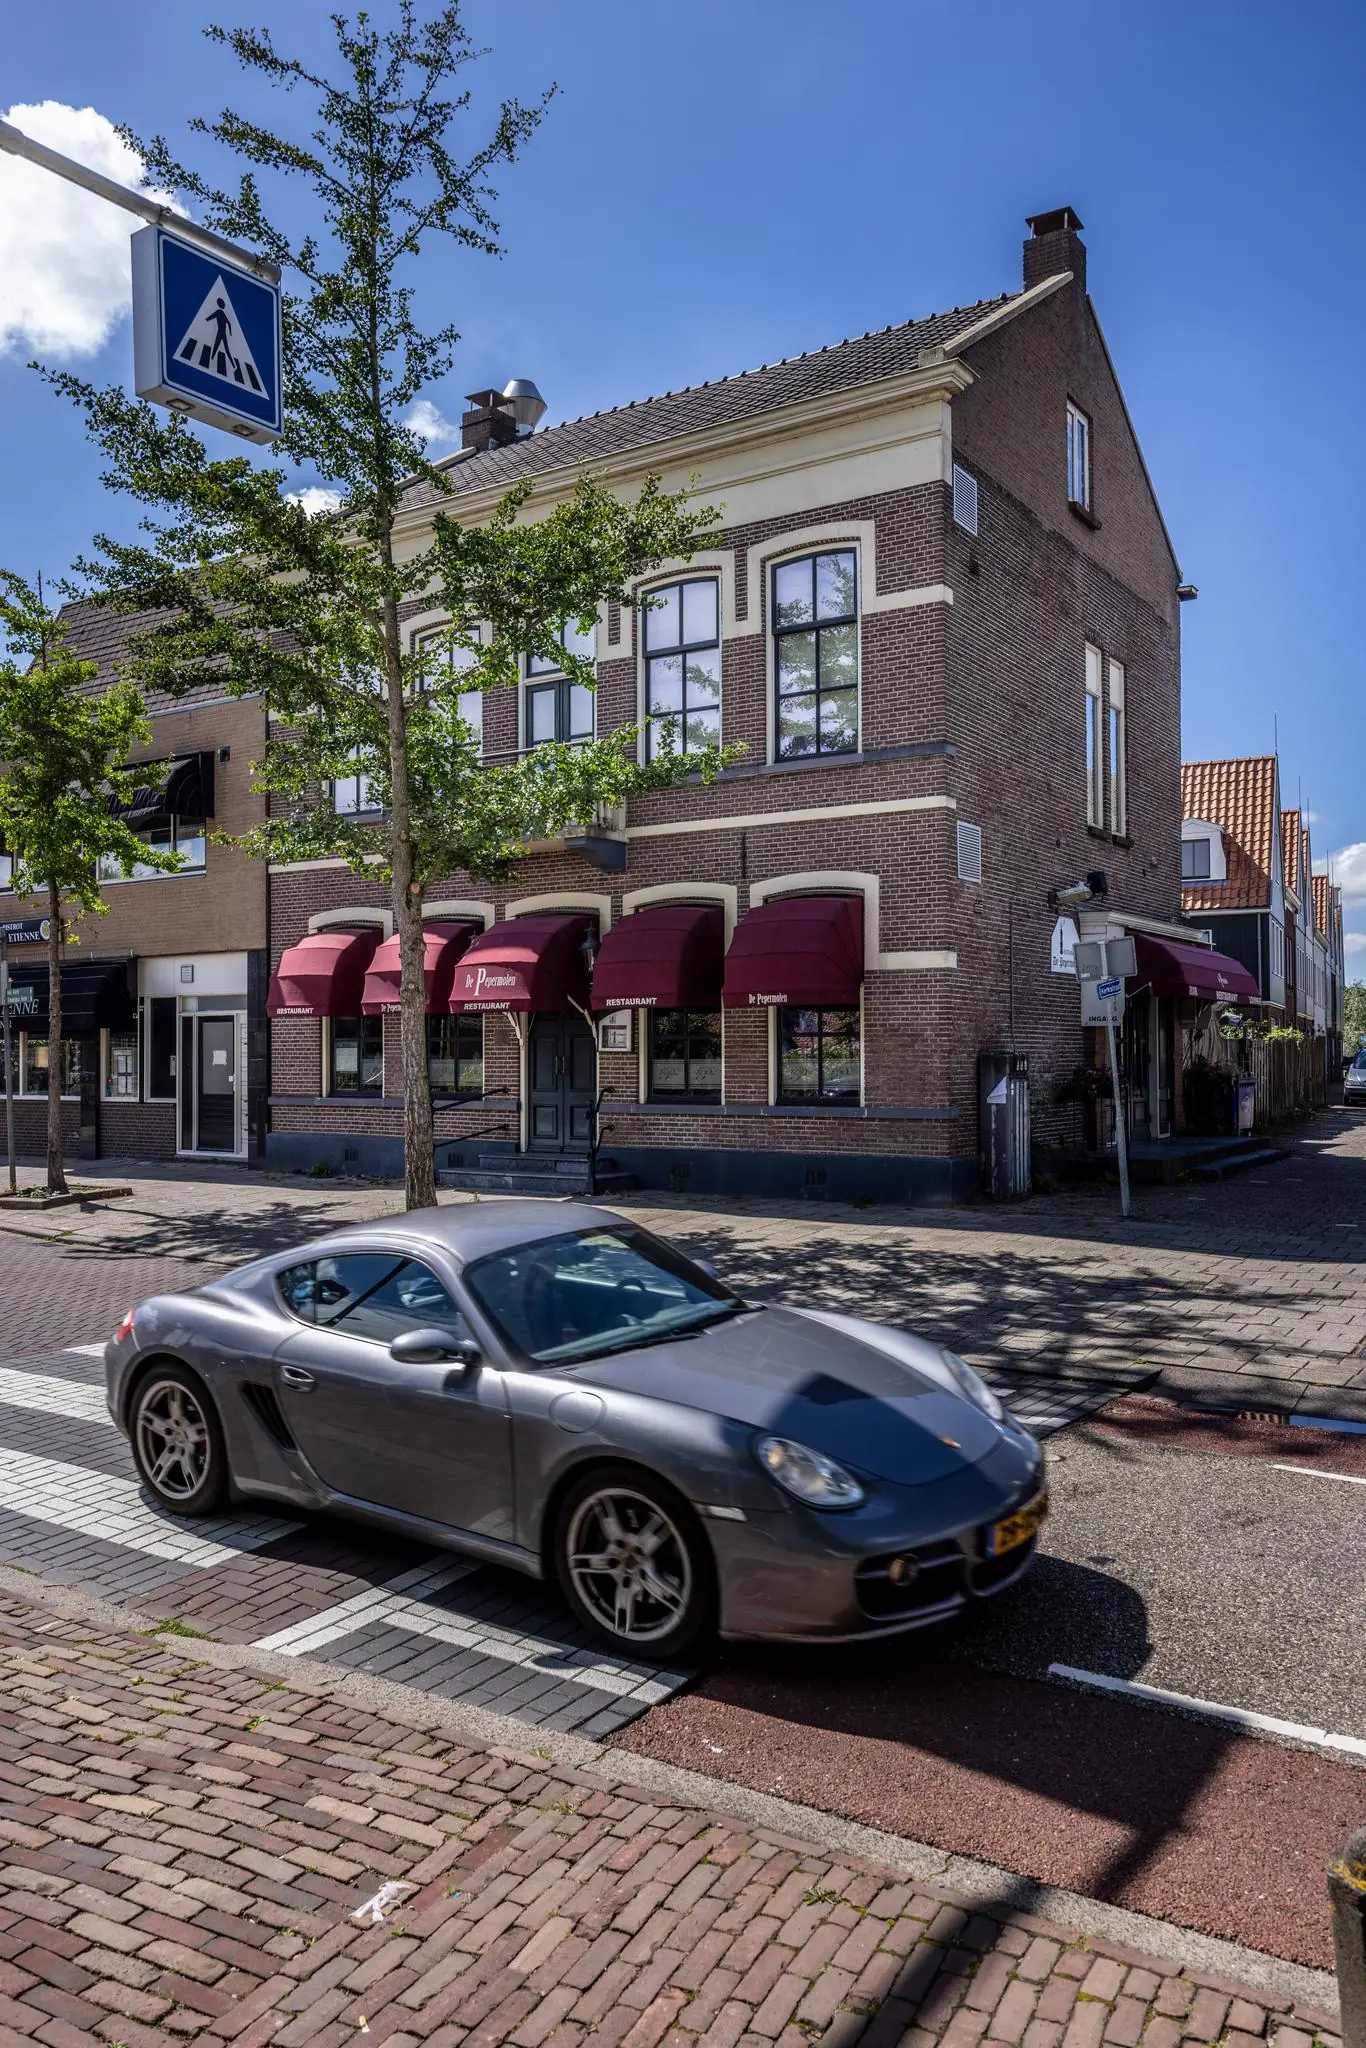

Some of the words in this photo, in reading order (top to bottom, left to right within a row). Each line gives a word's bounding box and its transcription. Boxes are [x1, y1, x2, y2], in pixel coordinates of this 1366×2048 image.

[8, 931, 41, 943] ETIENNE
[465, 974, 474, 988] De
[474, 968, 516, 996] Pepermolen
[606, 997, 657, 1006] RESTAURANT
[749, 993, 756, 1004] De
[757, 992, 788, 1005] Pepermolen
[464, 1002, 511, 1010] RESTAURANT
[276, 1007, 314, 1015] RESTAURANT
[1088, 1014, 1118, 1023] INGAG
